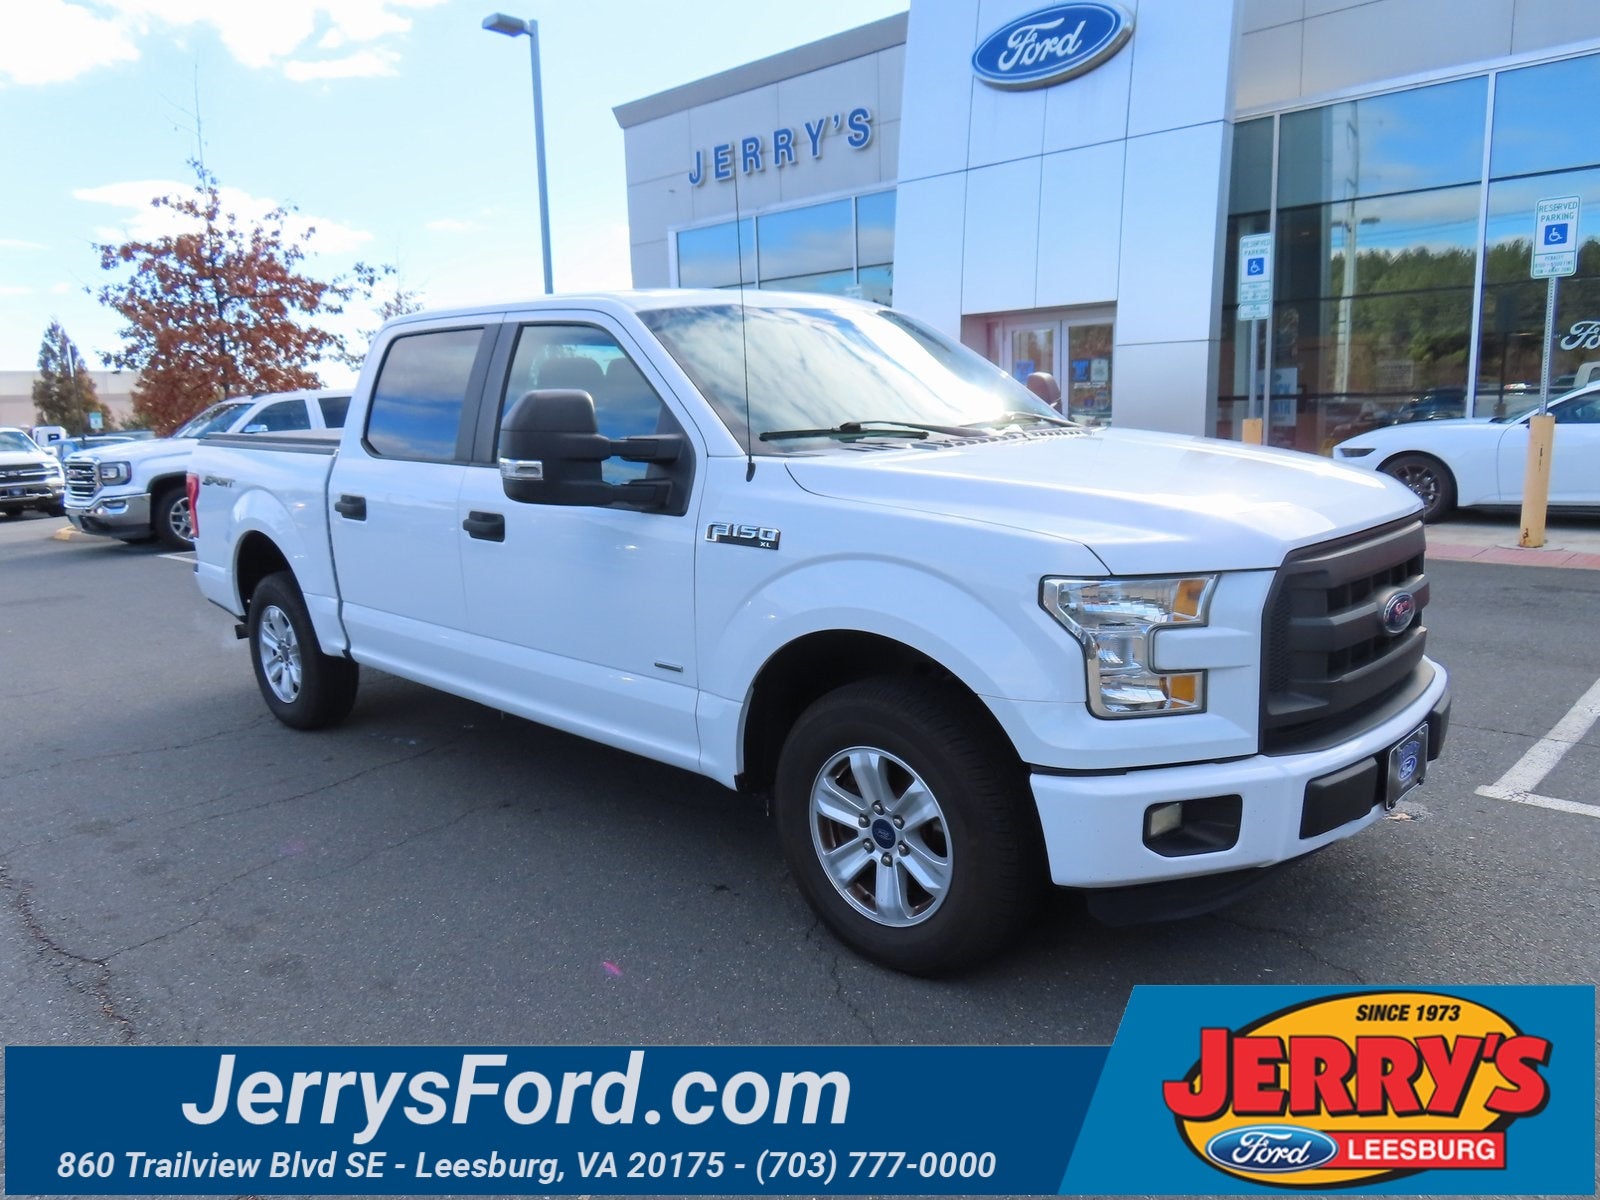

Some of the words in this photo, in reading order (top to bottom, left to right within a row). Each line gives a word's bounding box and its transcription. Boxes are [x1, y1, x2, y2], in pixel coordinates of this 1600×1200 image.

[998, 17, 1087, 71] Ford
[688, 107, 872, 185] JERRY'S
[1538, 201, 1578, 213] RESERVED
[1541, 212, 1575, 222] PARKING
